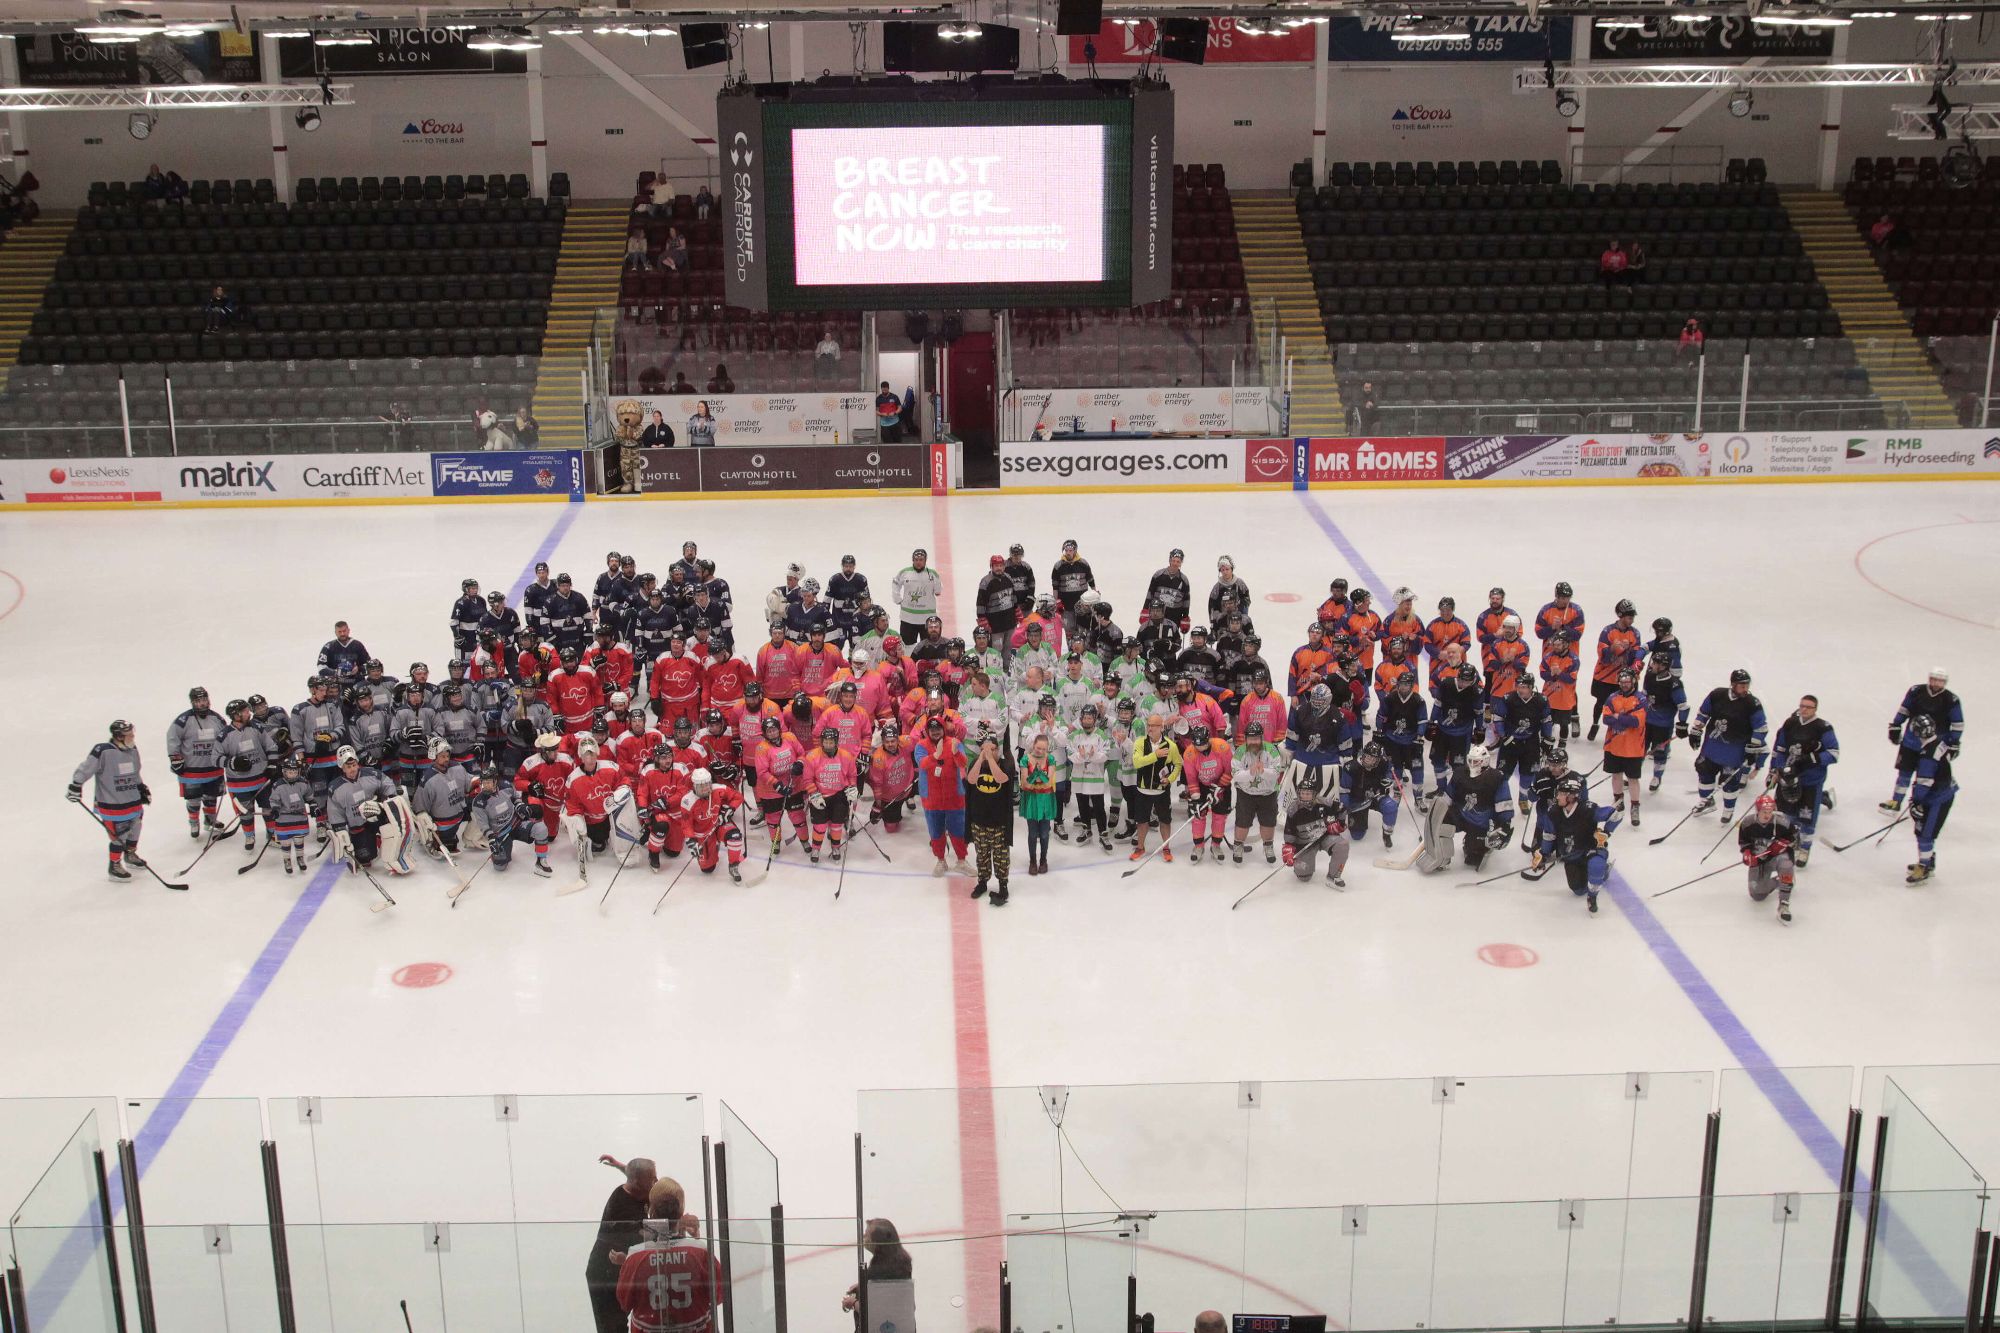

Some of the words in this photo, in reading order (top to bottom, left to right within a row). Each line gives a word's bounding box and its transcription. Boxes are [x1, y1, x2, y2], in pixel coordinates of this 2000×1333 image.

[389, 28, 463, 45] PICTON
[1446, 38, 1472, 52] 555
[1477, 38, 1503, 52] 555
[64, 45, 127, 62] POINTE
[378, 52, 431, 62] SALON
[1409, 104, 1452, 120] Coors
[420, 119, 464, 134] Coors
[834, 156, 1001, 189] BREAST
[832, 189, 1011, 220] CANCER
[1149, 135, 1158, 270] visitcardiff.com
[743, 173, 753, 263] CARDIFF
[734, 173, 746, 282] CAERDYDD
[947, 224, 979, 235] The
[836, 223, 937, 252] NOW
[769, 397, 796, 405] amber
[1094, 392, 1120, 400] amber
[839, 403, 867, 411] energy
[1094, 399, 1121, 407] energy
[1165, 398, 1192, 406] energy
[1235, 398, 1263, 406] energy
[769, 404, 796, 412] energy
[734, 419, 760, 427] amber
[806, 418, 831, 426] amber
[1200, 419, 1227, 427] energy
[734, 425, 762, 433] energy
[805, 424, 832, 432] energy
[1781, 435, 1811, 444] Support
[1886, 438, 1922, 450] RMB
[1580, 447, 1590, 456] THE
[1592, 447, 1605, 456] BEST
[1606, 447, 1622, 456] STUFF
[1625, 446, 1639, 456] WITH
[1641, 446, 1658, 456] EXTRA
[1000, 453, 1228, 476] ssexgarages.com
[1315, 453, 1350, 471] MR
[1357, 451, 1437, 470] HOMES
[1453, 449, 1506, 480] PURPLE
[1580, 457, 1627, 466] PIZZAHUT.CO.UK
[1884, 452, 1975, 467] Hydroseeding
[69, 467, 131, 478] LexisNexis
[303, 467, 384, 487] Cardiff
[384, 467, 425, 487] Met
[442, 464, 513, 482] FRAME
[647, 472, 680, 480] HOTEL
[720, 471, 761, 479] CLAYTON
[764, 470, 797, 478] HOTEL
[835, 469, 876, 477] CLAYTON
[200, 489, 231, 499] Workplace
[232, 489, 257, 498] Services
[650, 1252, 687, 1266] GRANT
[648, 1272, 693, 1311] 85
